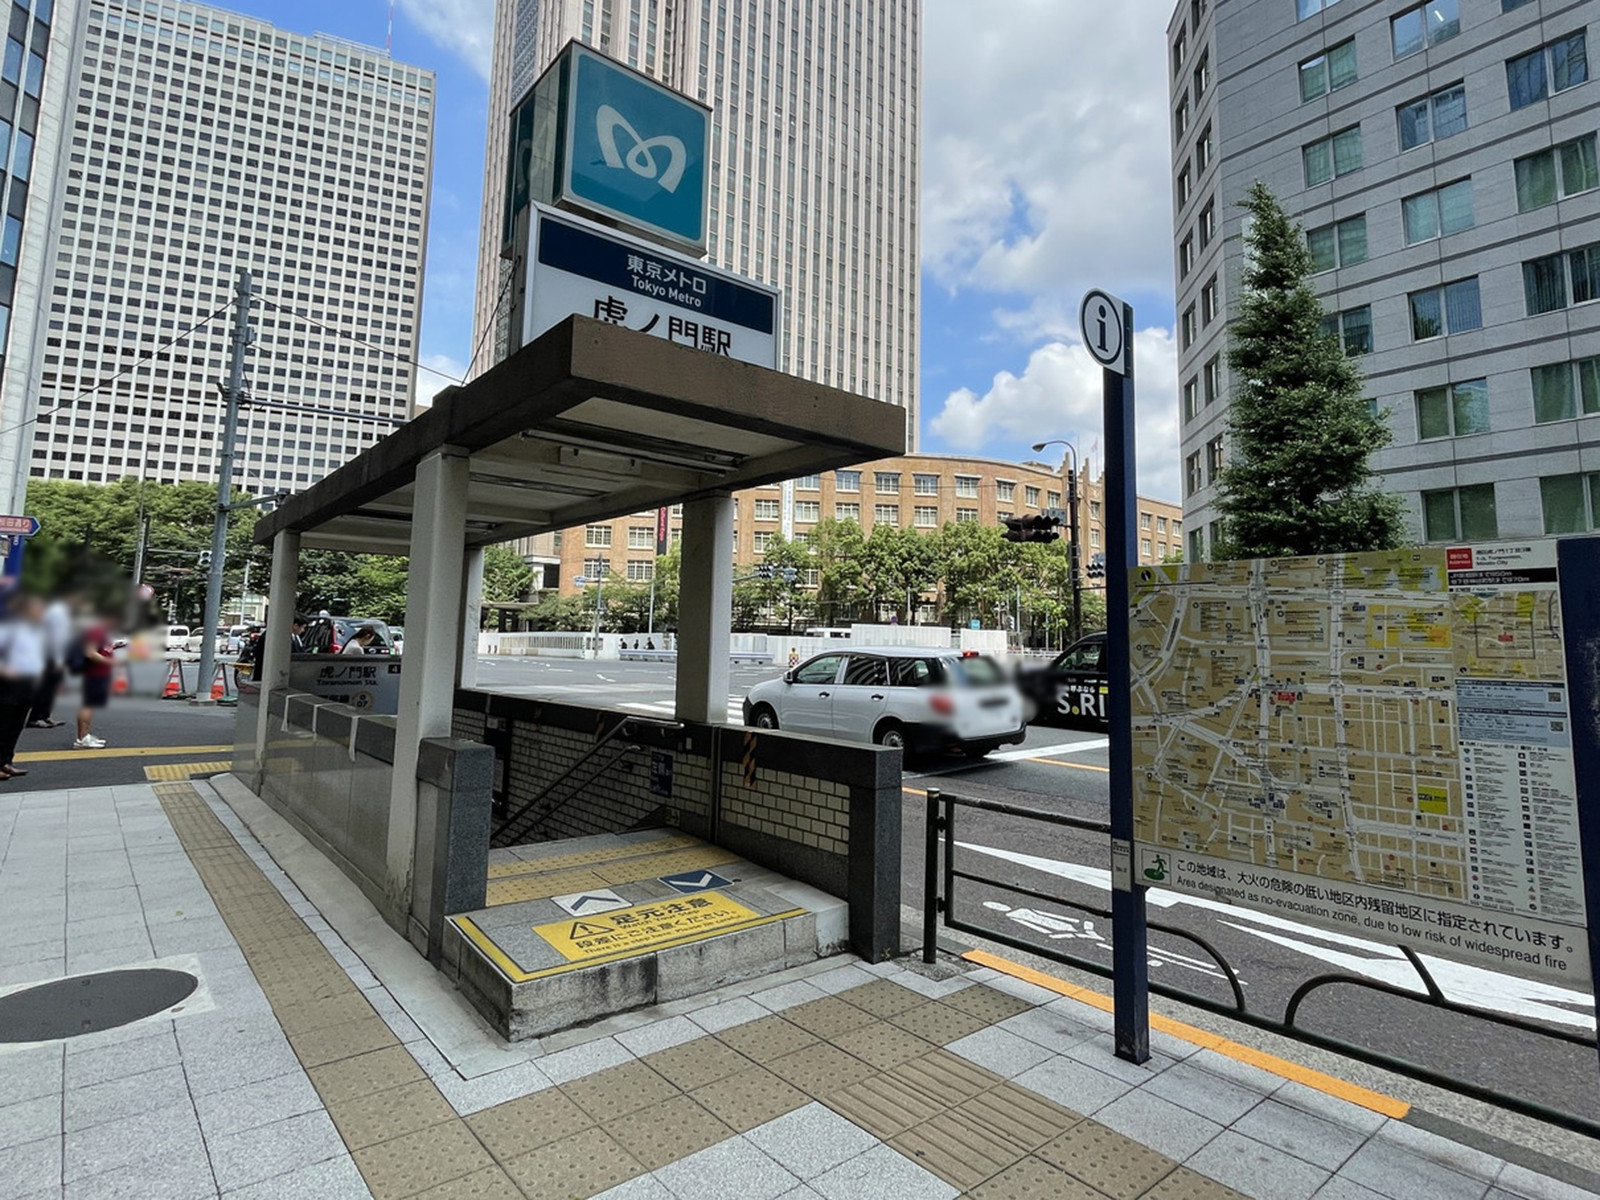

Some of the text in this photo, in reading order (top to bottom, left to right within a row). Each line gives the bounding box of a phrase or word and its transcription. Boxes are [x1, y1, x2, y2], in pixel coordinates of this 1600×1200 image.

[626, 254, 707, 295] 東京メトロ
[631, 274, 702, 308] Tokyo Metro
[319, 665, 377, 679] 虎ノ門駅
[609, 898, 713, 926] 足元注意
[1176, 875, 1568, 971] Area designated as no-evacuation zone, due to low risk of widespread fire
[1177, 859, 1574, 954] この地域は、大火の危険の低い地区内残留地区に指定されています。
